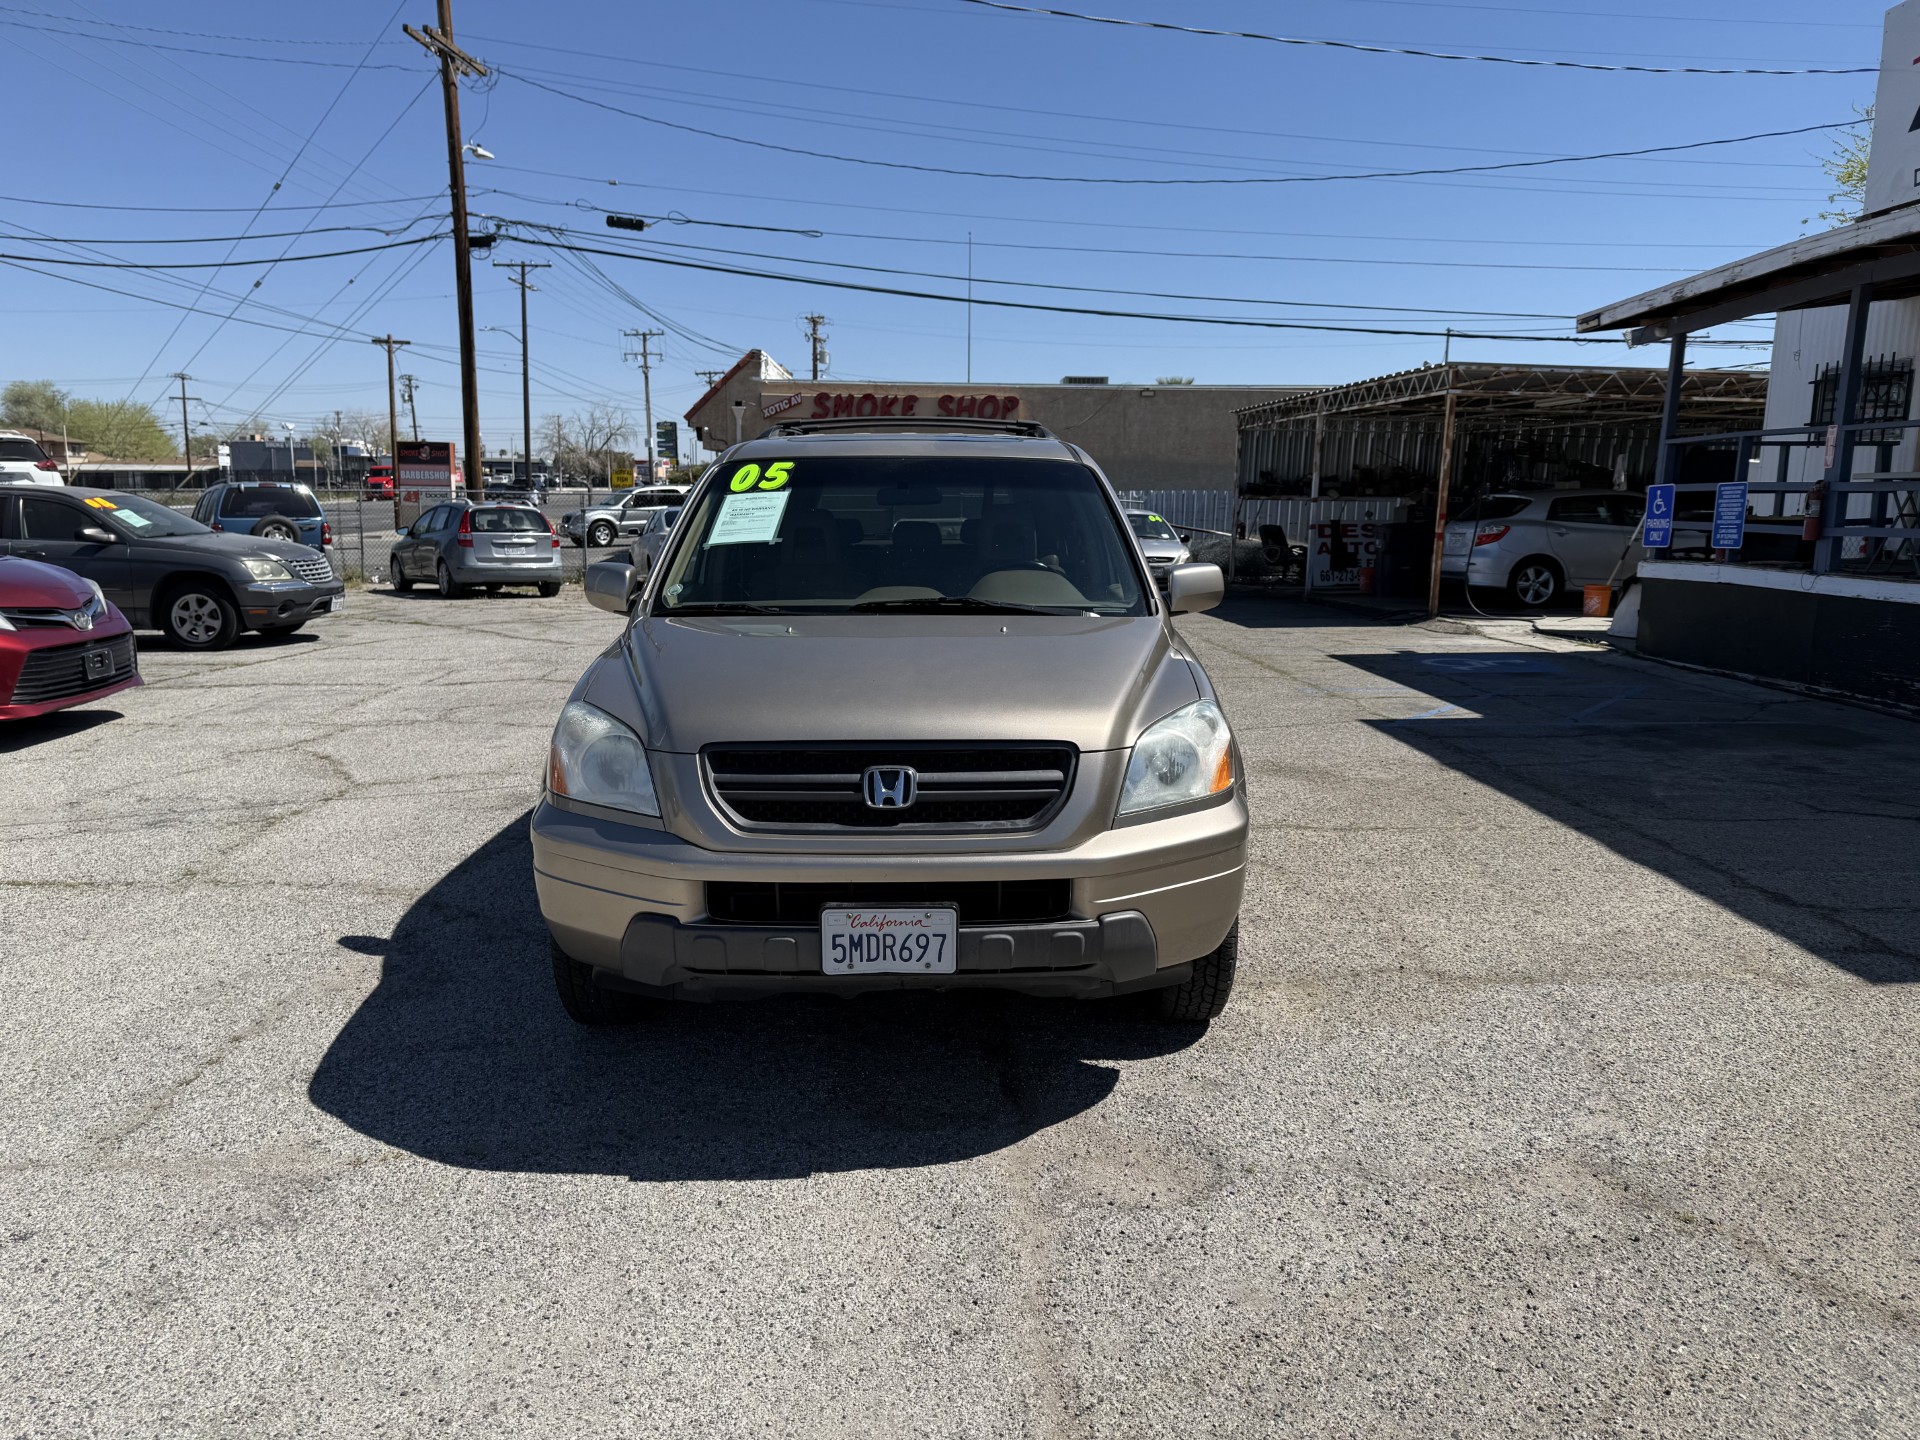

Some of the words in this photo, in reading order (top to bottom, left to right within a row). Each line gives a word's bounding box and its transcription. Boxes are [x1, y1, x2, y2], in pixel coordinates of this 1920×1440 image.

[762, 399, 790, 418] XOTIC
[811, 392, 919, 418] SMOKE
[937, 395, 1020, 420] SHOP
[400, 449, 419, 457] SMOKE
[431, 449, 449, 457] SHOP
[400, 470, 449, 480] BARBERSHOP
[730, 461, 796, 492] 05
[1646, 518, 1670, 529] PARKING
[1649, 531, 1664, 541] ONLY
[850, 913, 932, 932] California
[831, 933, 947, 964] 5MDR697
